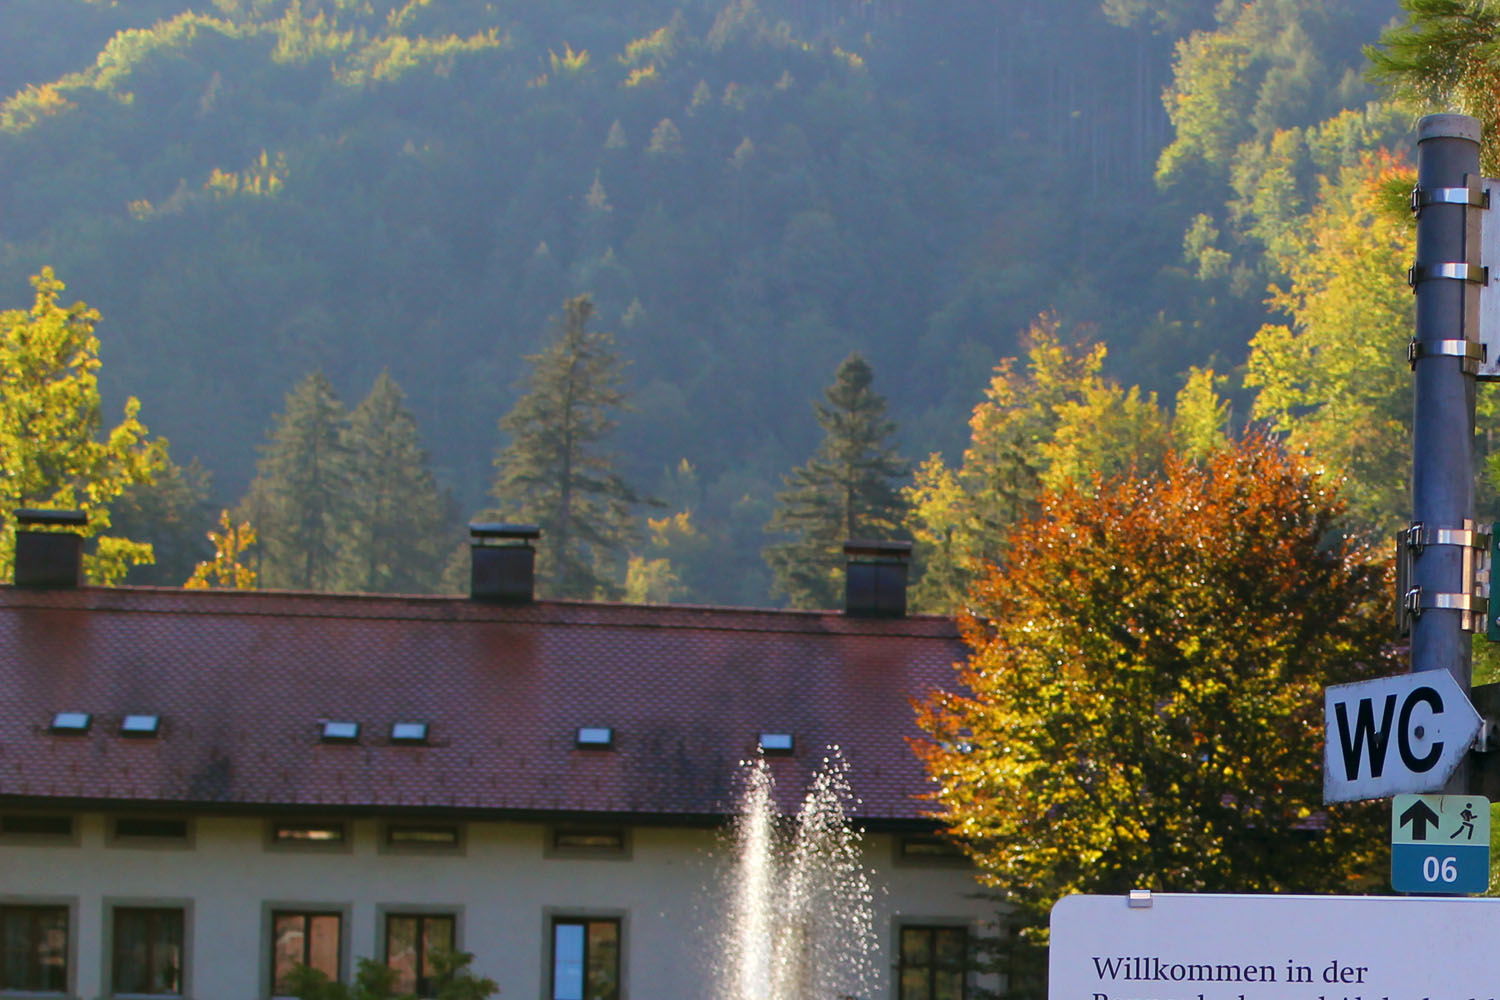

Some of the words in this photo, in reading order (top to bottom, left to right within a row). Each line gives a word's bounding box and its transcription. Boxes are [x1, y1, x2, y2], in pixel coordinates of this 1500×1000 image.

[1334, 687, 1444, 782] WC
[1423, 856, 1458, 882] 06
[1092, 957, 1277, 982] Willkommen
[1286, 959, 1314, 983] in
[1322, 960, 1368, 984] der
